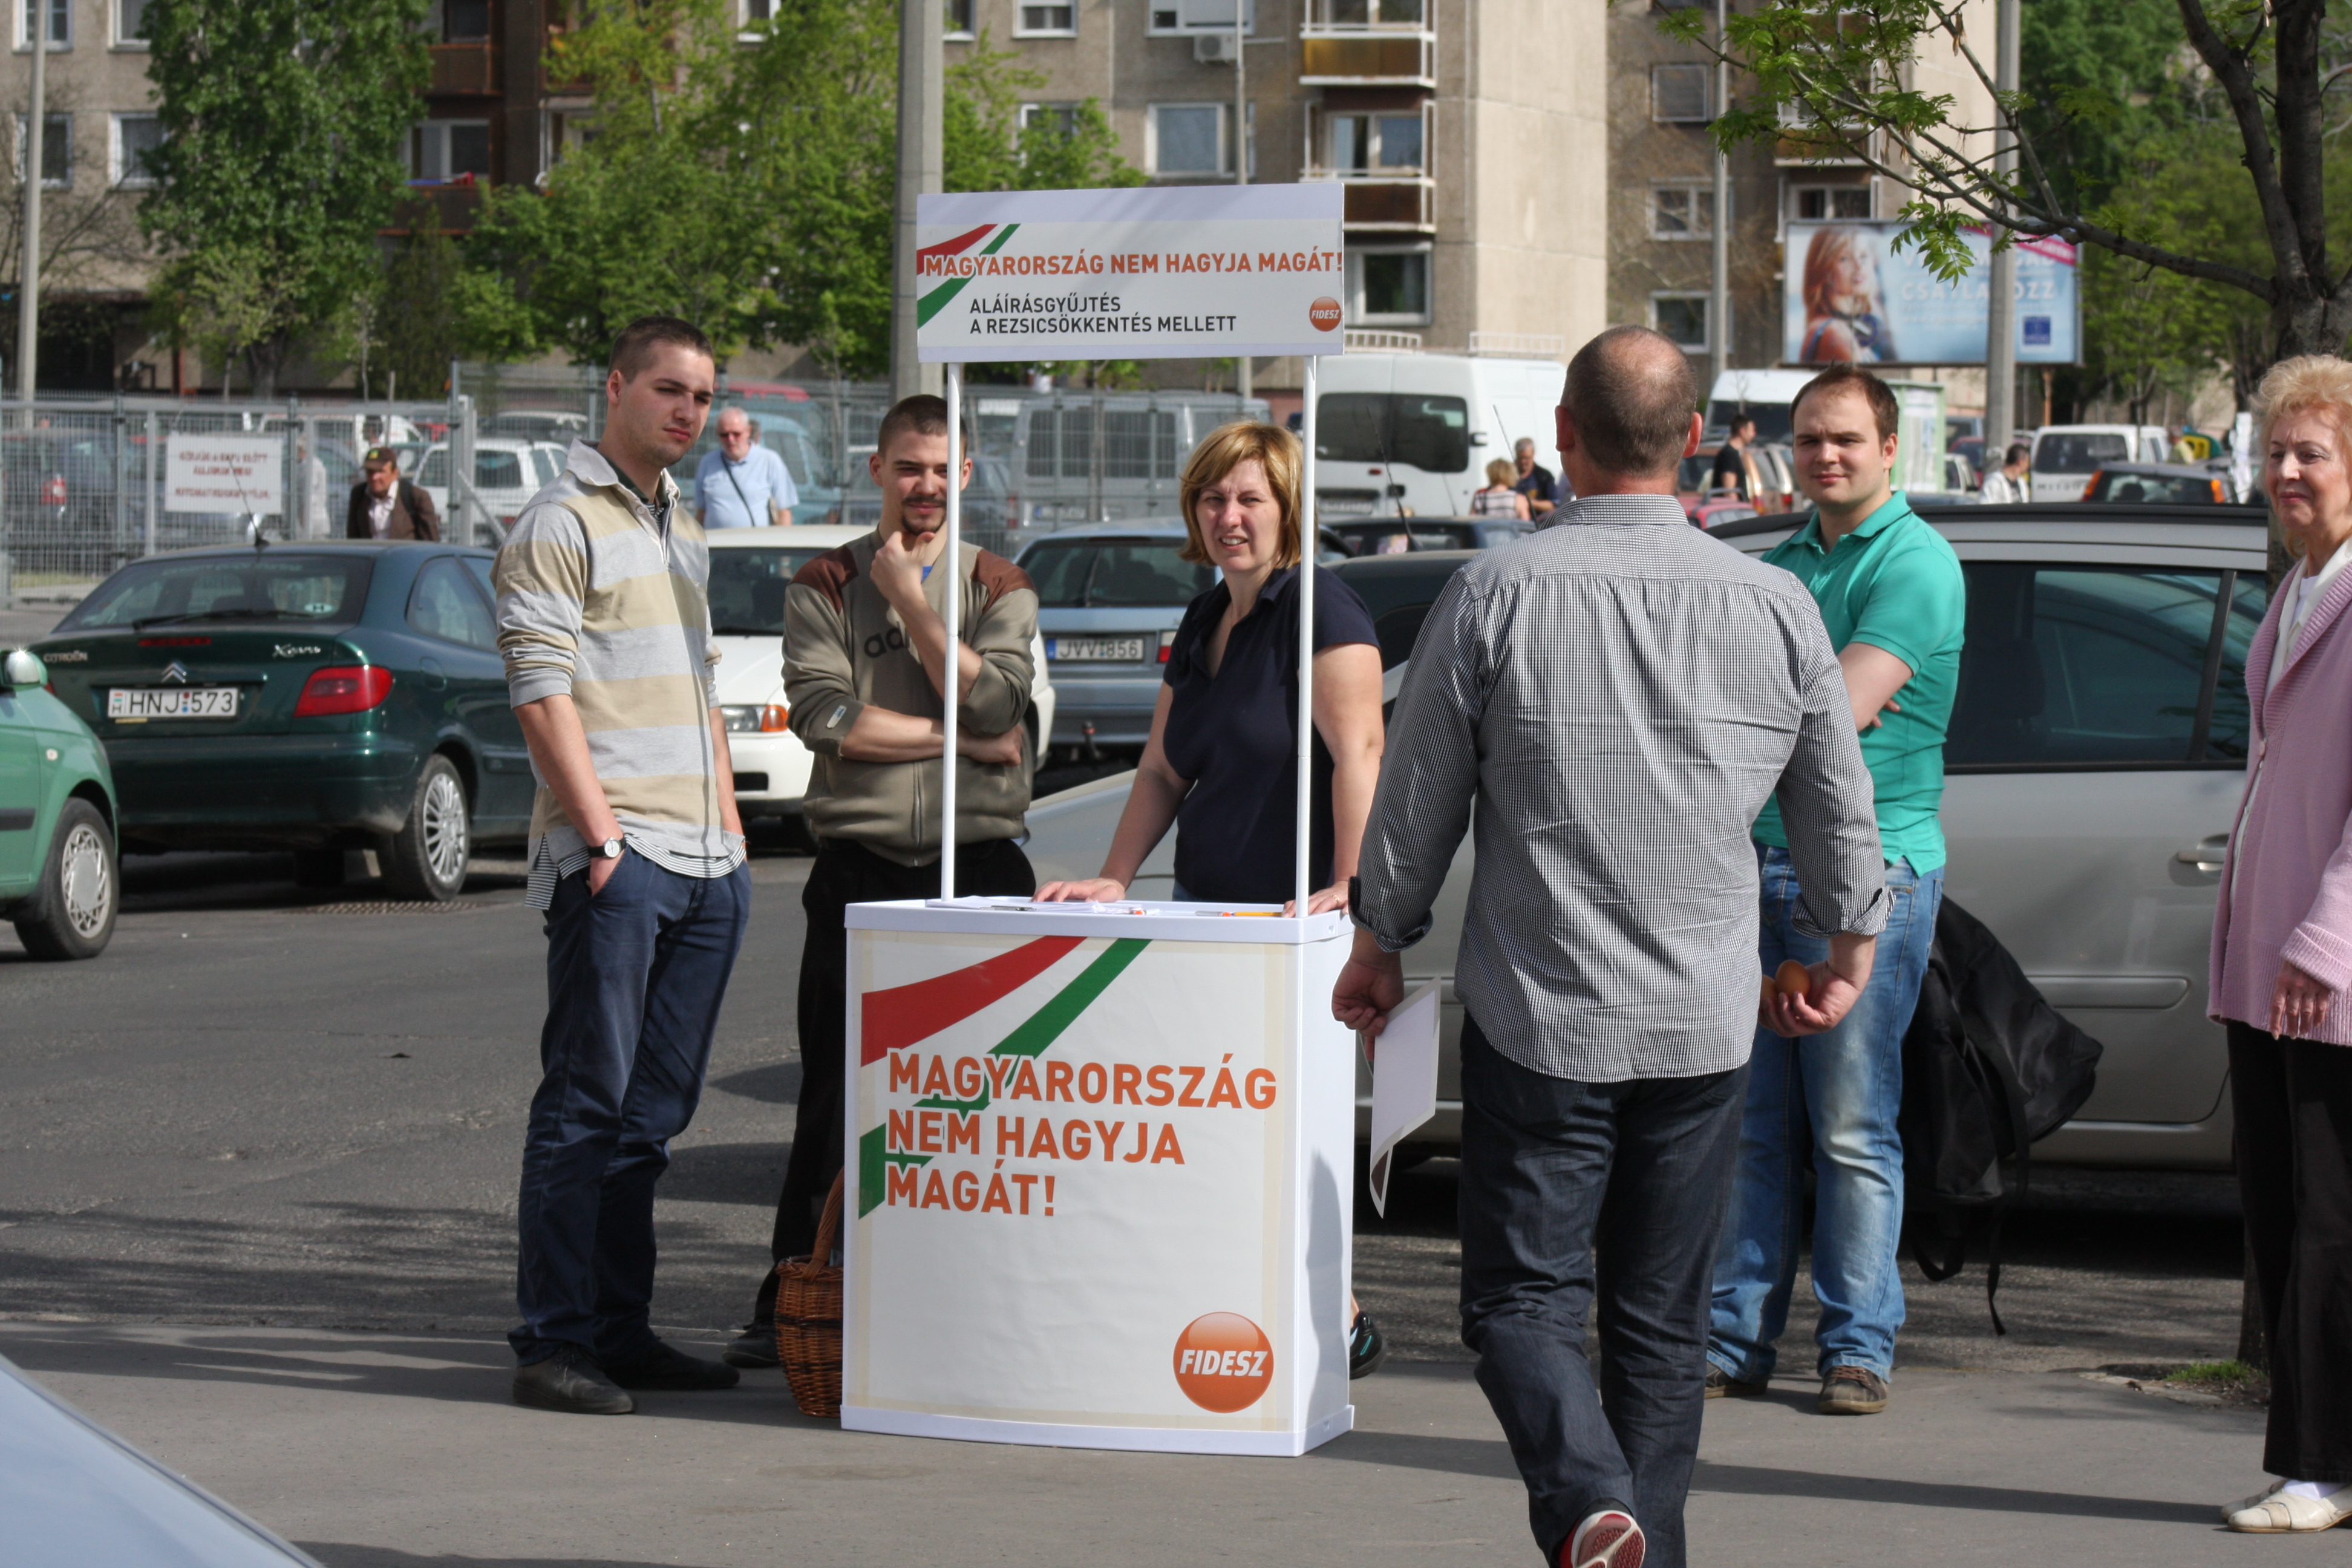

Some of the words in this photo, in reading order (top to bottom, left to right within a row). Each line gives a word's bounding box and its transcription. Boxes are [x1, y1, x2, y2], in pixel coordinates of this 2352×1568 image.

[926, 249, 1103, 276] MAGYARORSZÁG
[1111, 254, 1158, 273] NEM
[1166, 253, 1252, 272] HAGYJA
[1258, 246, 1342, 272] MAGÁT!
[970, 292, 1121, 313] ALÁÍRÁSGYŰJTÉS
[1902, 281, 2055, 300] CSATLAOZZ
[970, 319, 981, 333] A
[987, 312, 1152, 333] REZSICSÖKKENTÉS
[1158, 316, 1236, 332] MELLETT
[1311, 309, 1339, 319] FIDESZ
[43, 650, 88, 663] CITROËN
[889, 1053, 1277, 1110] MAGYARORSZÁG
[888, 1109, 980, 1155] NEM
[996, 1116, 1186, 1165] HAGYJA
[887, 1158, 1056, 1217] MAGÁT!
[1180, 1349, 1269, 1377] FIDESZ
